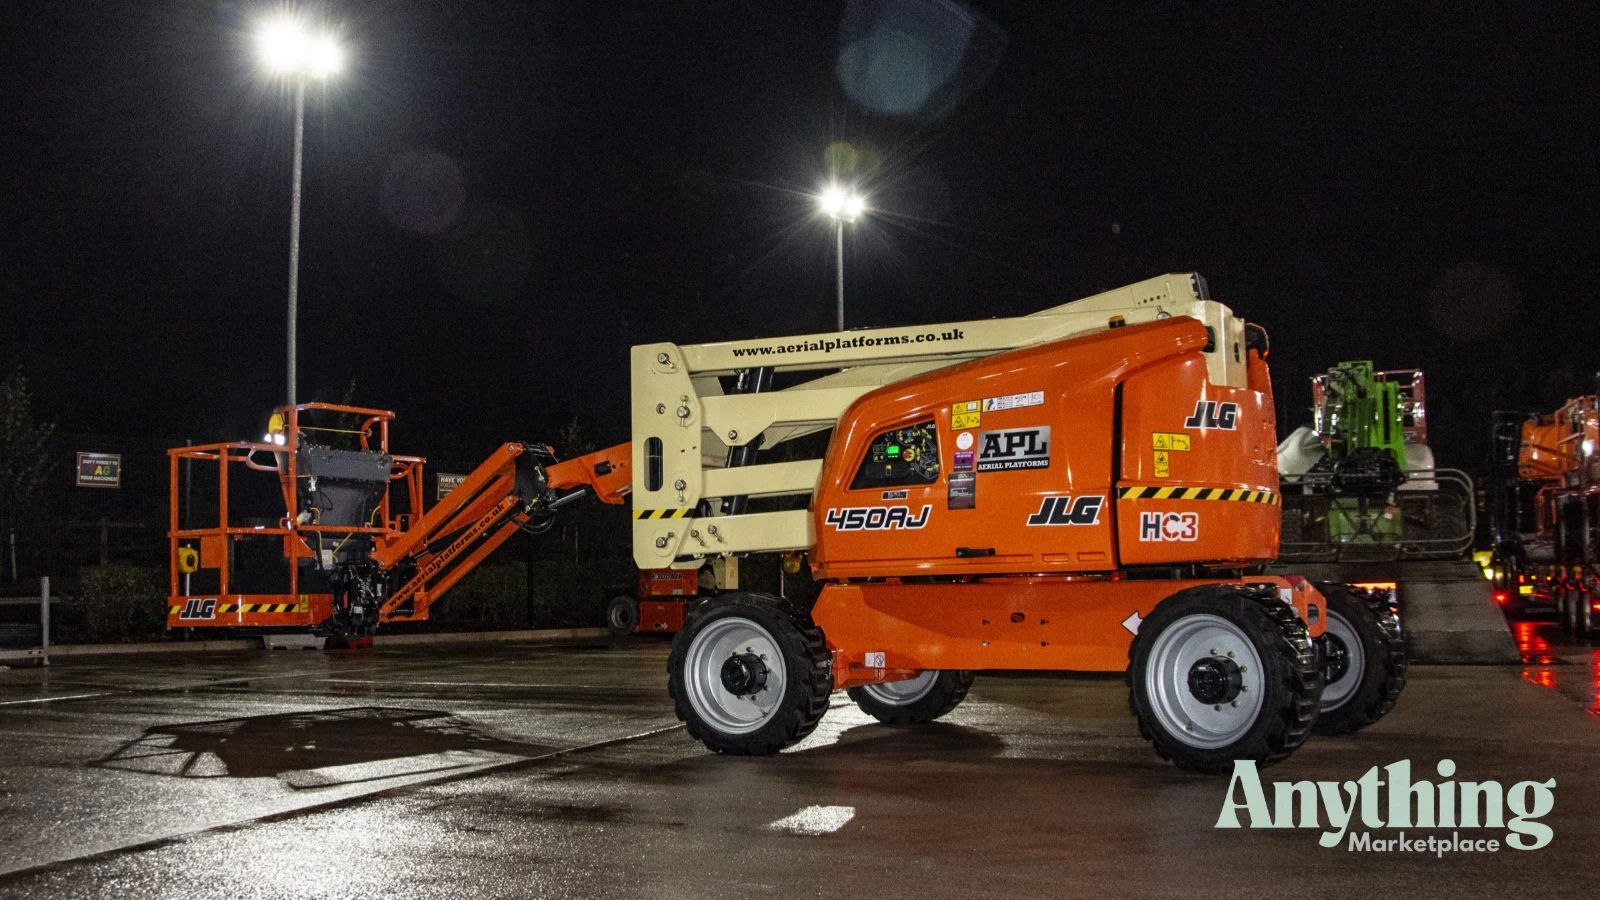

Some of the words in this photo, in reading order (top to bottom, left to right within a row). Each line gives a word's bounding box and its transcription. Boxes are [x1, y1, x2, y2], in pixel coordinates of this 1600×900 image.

[732, 329, 964, 357] www.aerialplatforms.co.uk
[1184, 400, 1238, 430] JLG
[979, 430, 1047, 459] APL
[977, 461, 1004, 471] AERIAL
[1004, 459, 1049, 469] PLATFORMS
[825, 504, 932, 531] 450AJ
[1026, 495, 1105, 526] JLG
[1139, 511, 1199, 541] HC3
[388, 503, 505, 607] www.aerialplatforms.co.uk
[179, 598, 218, 620] JLG
